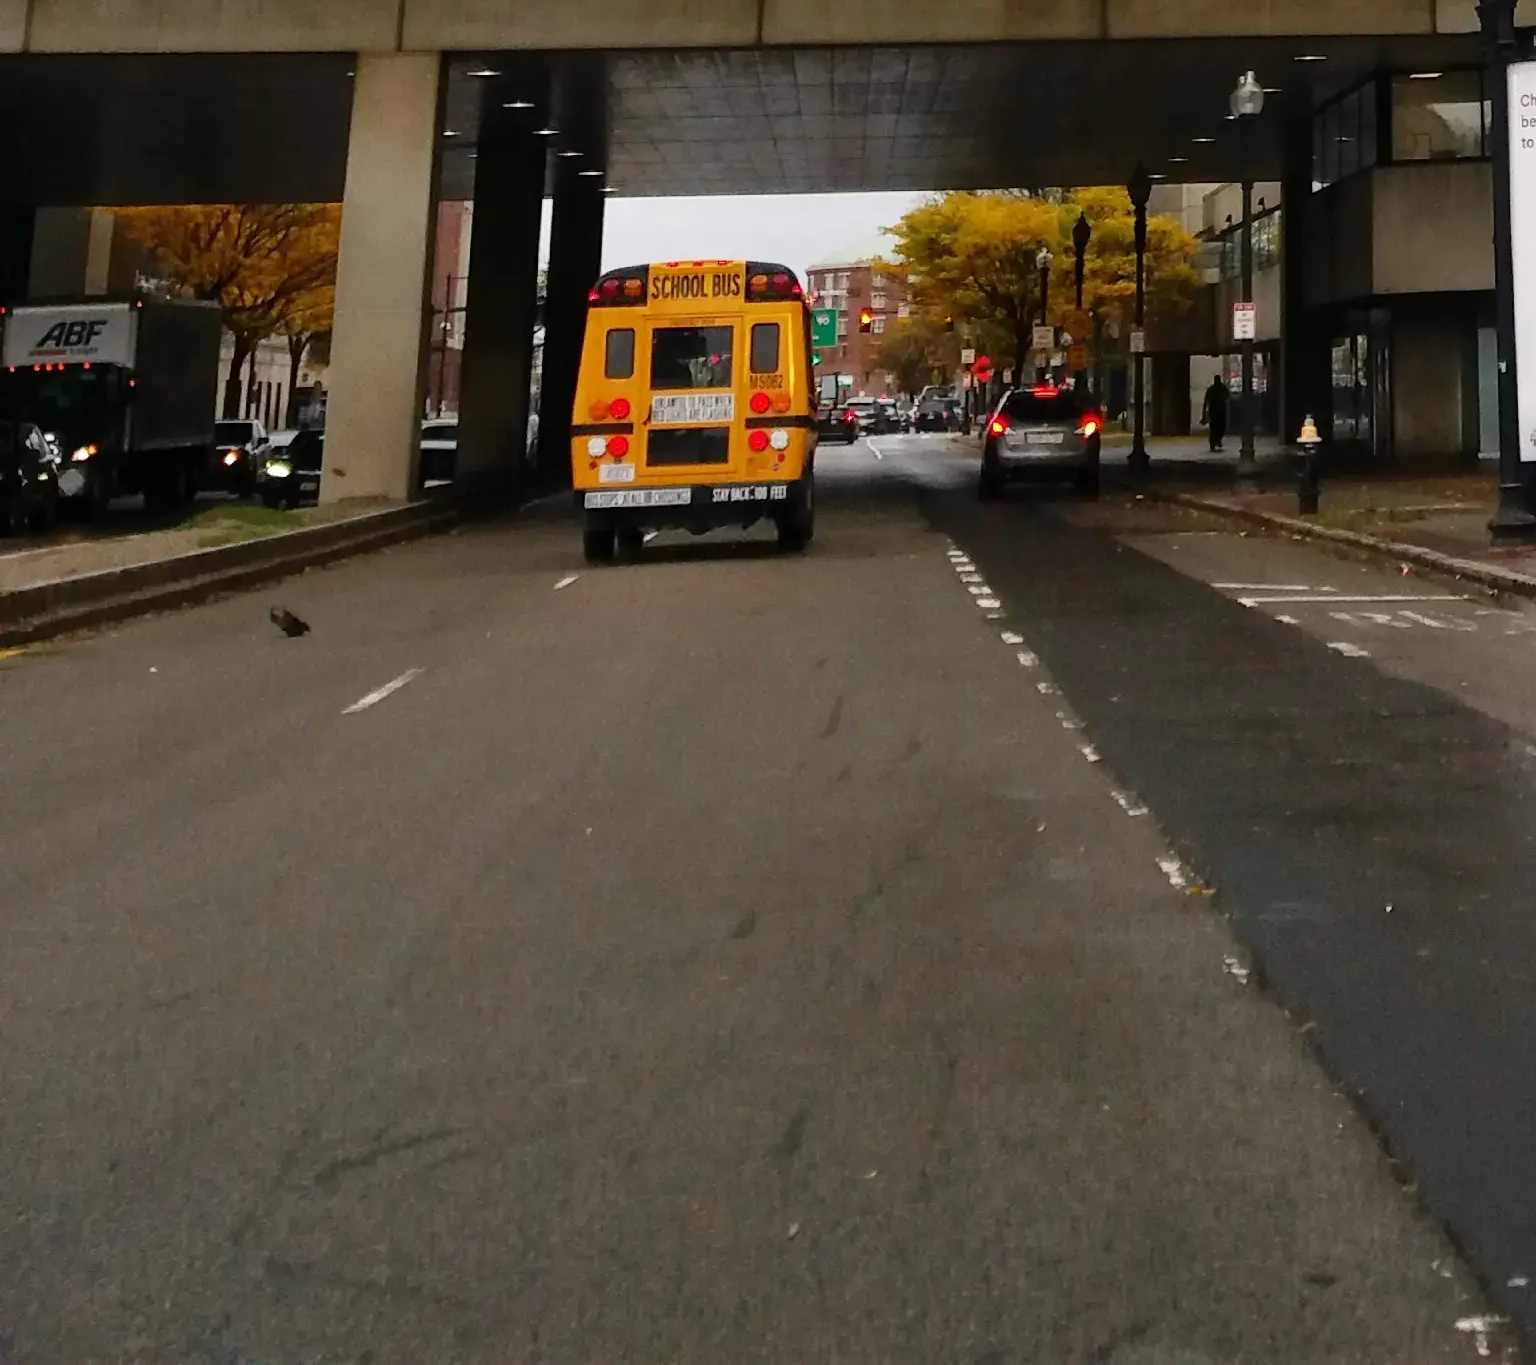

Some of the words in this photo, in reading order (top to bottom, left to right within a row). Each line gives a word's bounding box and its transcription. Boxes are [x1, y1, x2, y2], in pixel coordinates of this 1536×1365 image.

[1521, 137, 1535, 149] to
[651, 274, 708, 299] SCHOOL
[712, 273, 741, 298] BUS
[36, 320, 108, 348] ABF
[712, 488, 730, 503] STAY
[730, 487, 749, 502] BACK
